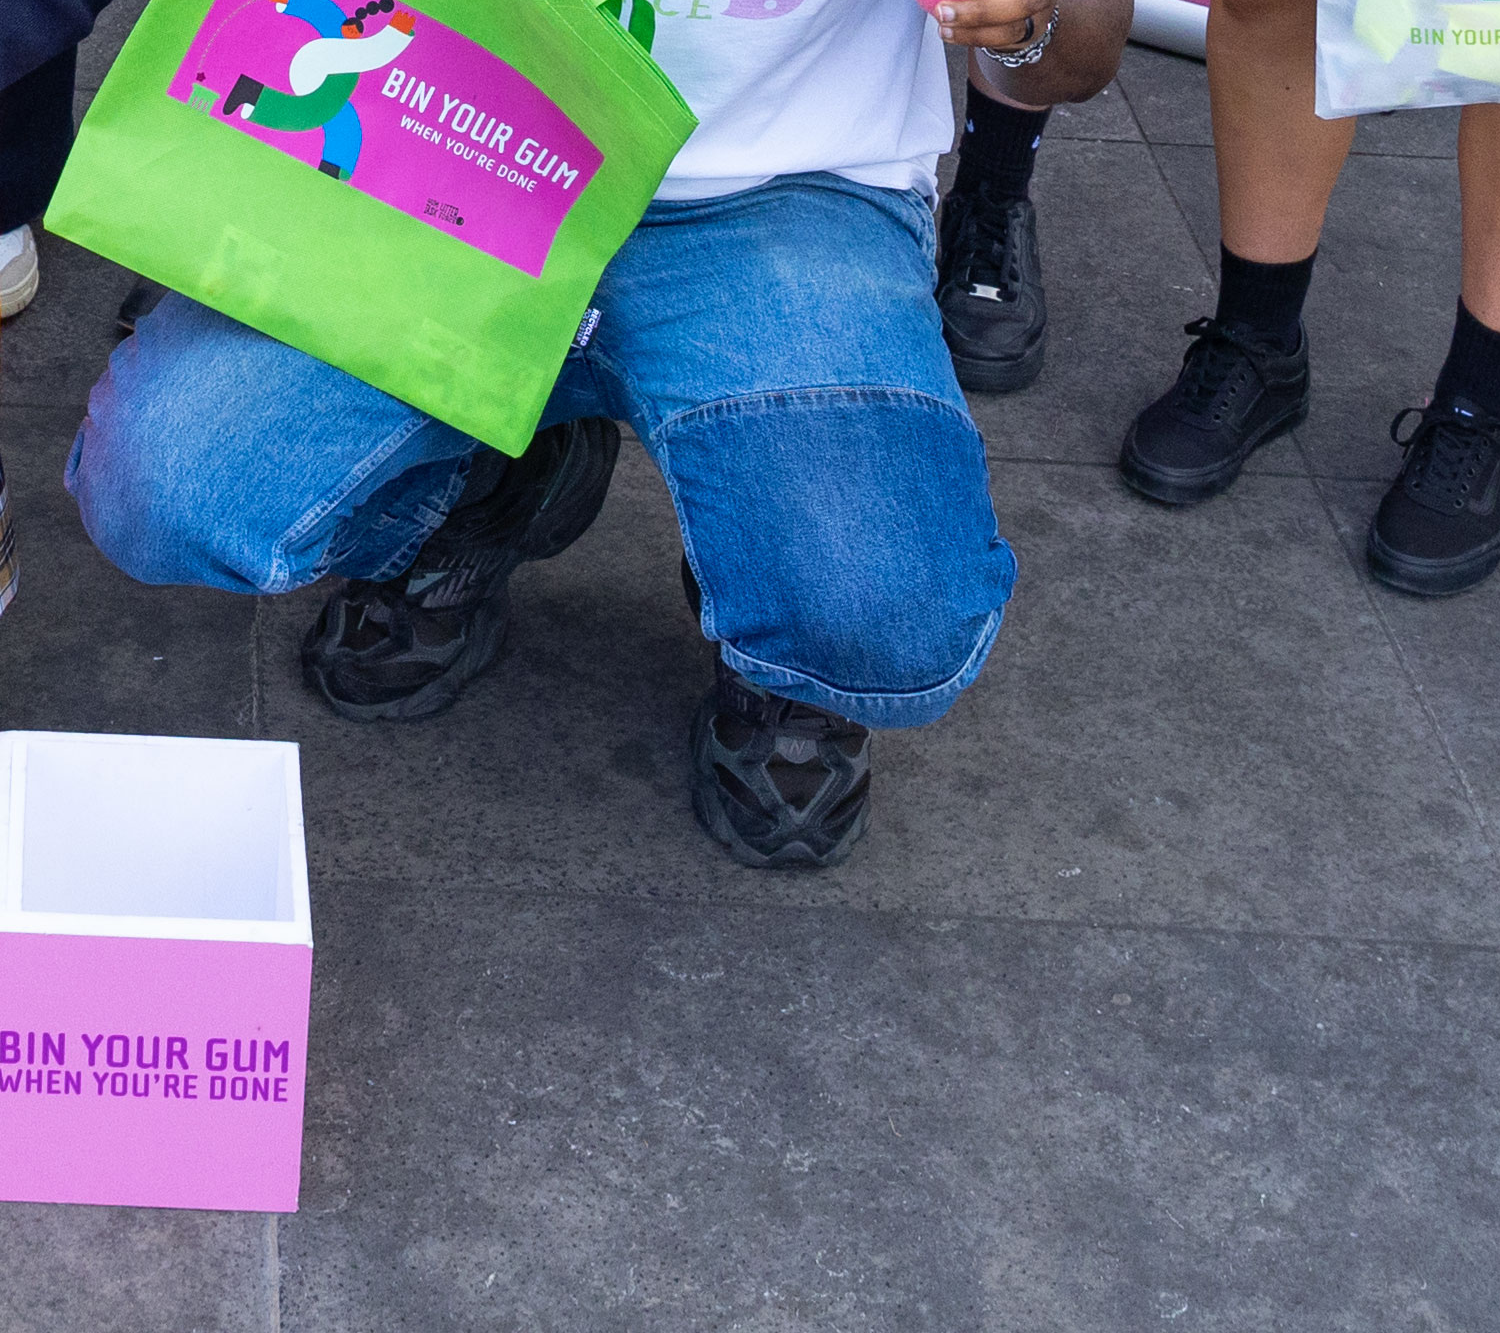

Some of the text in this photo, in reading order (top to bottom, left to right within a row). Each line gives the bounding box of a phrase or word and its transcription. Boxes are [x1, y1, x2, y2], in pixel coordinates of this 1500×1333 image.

[1410, 27, 1445, 46] BIN
[380, 65, 580, 193] BIN YOUR GUM
[400, 113, 539, 195] WHEN YOU'RE DONE
[580, 308, 599, 346] RECYCLED
[0, 1031, 290, 1074] BIN YOUR GUM
[92, 1072, 198, 1100] YOU'RE
[210, 1076, 289, 1102] DONE
